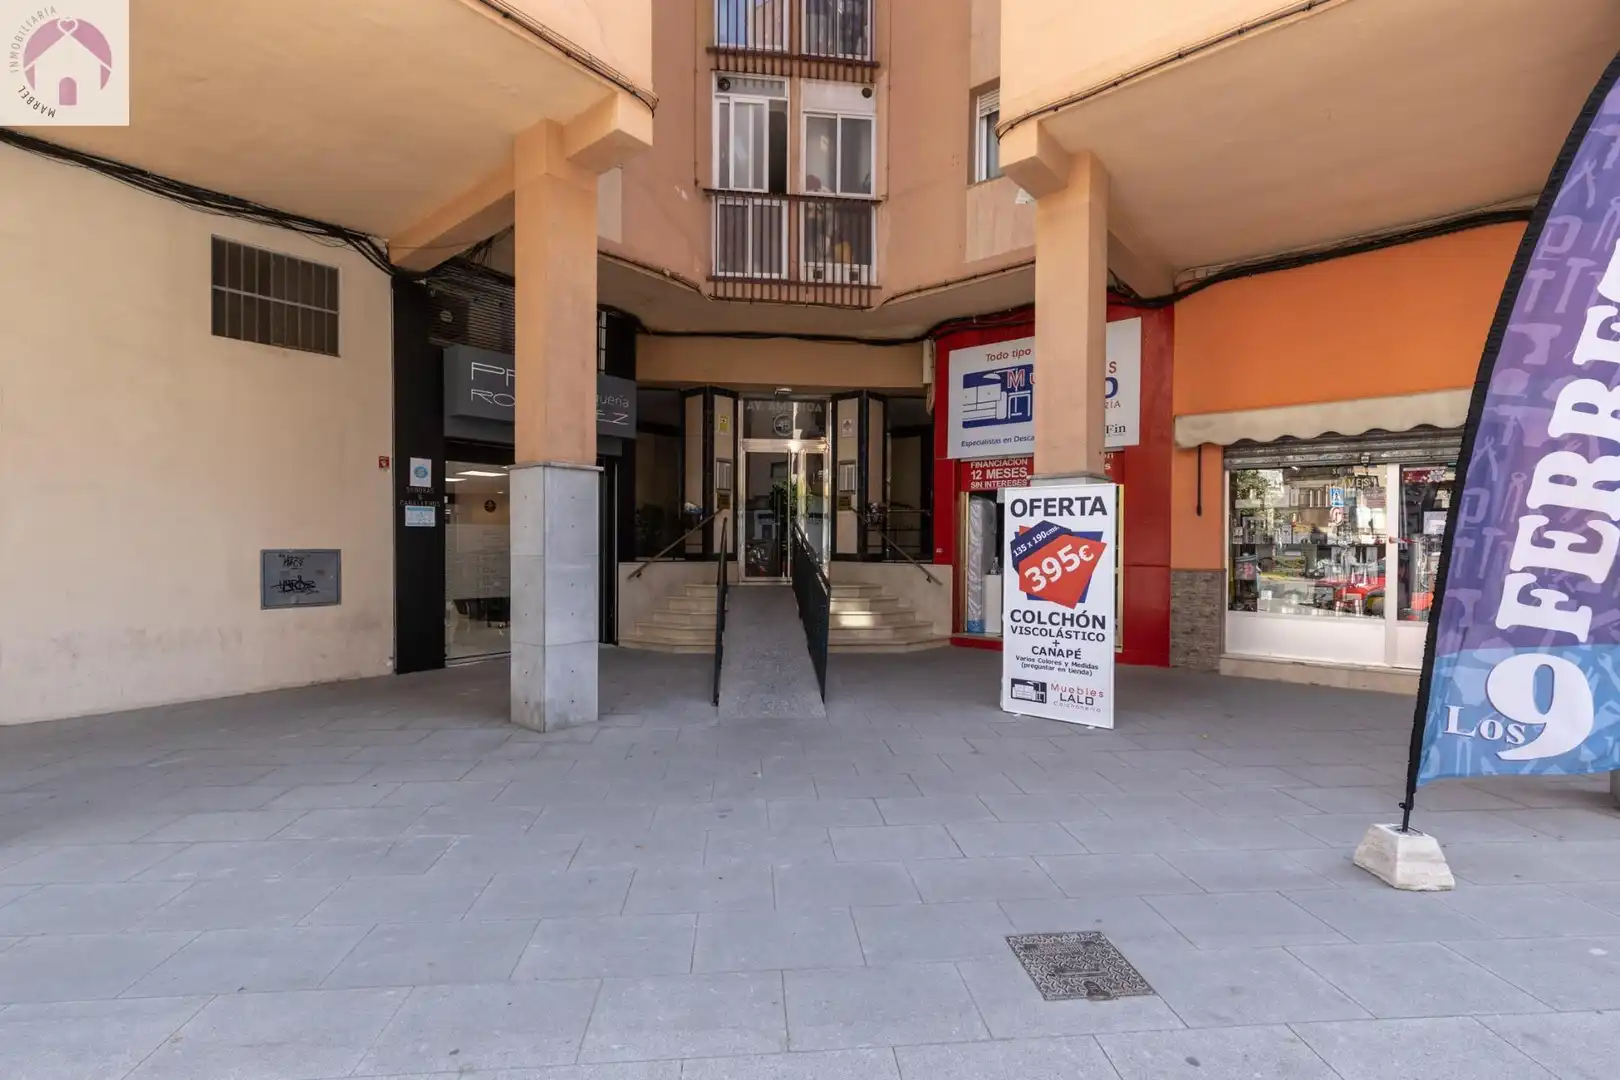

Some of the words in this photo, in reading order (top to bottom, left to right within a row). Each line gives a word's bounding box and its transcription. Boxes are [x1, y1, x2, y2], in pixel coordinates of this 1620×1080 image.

[985, 351, 1009, 362] Todo
[1012, 348, 1032, 360] tipo
[961, 438, 1002, 448] Especialistas
[970, 469, 983, 480] 12
[986, 467, 1028, 479] MESES
[970, 481, 983, 489] SIN
[984, 479, 1028, 488] INTERESES
[1010, 496, 1108, 518] OFERTA
[1012, 543, 1028, 557] 135
[1024, 544, 1095, 593] 395€
[1010, 609, 1106, 630] COLCHÓN
[1010, 625, 1106, 643] VISCOLÁSTICO
[1031, 646, 1082, 660] CANAPÉ
[1015, 654, 1036, 663] Varios
[1037, 657, 1062, 666] Colores
[1071, 661, 1099, 670] Medidas
[1021, 661, 1055, 671] (preguntar
[1068, 667, 1093, 677] tienda)
[1051, 683, 1104, 698] Muebles
[1059, 692, 1094, 706] LALO
[1485, 653, 1594, 760] 9
